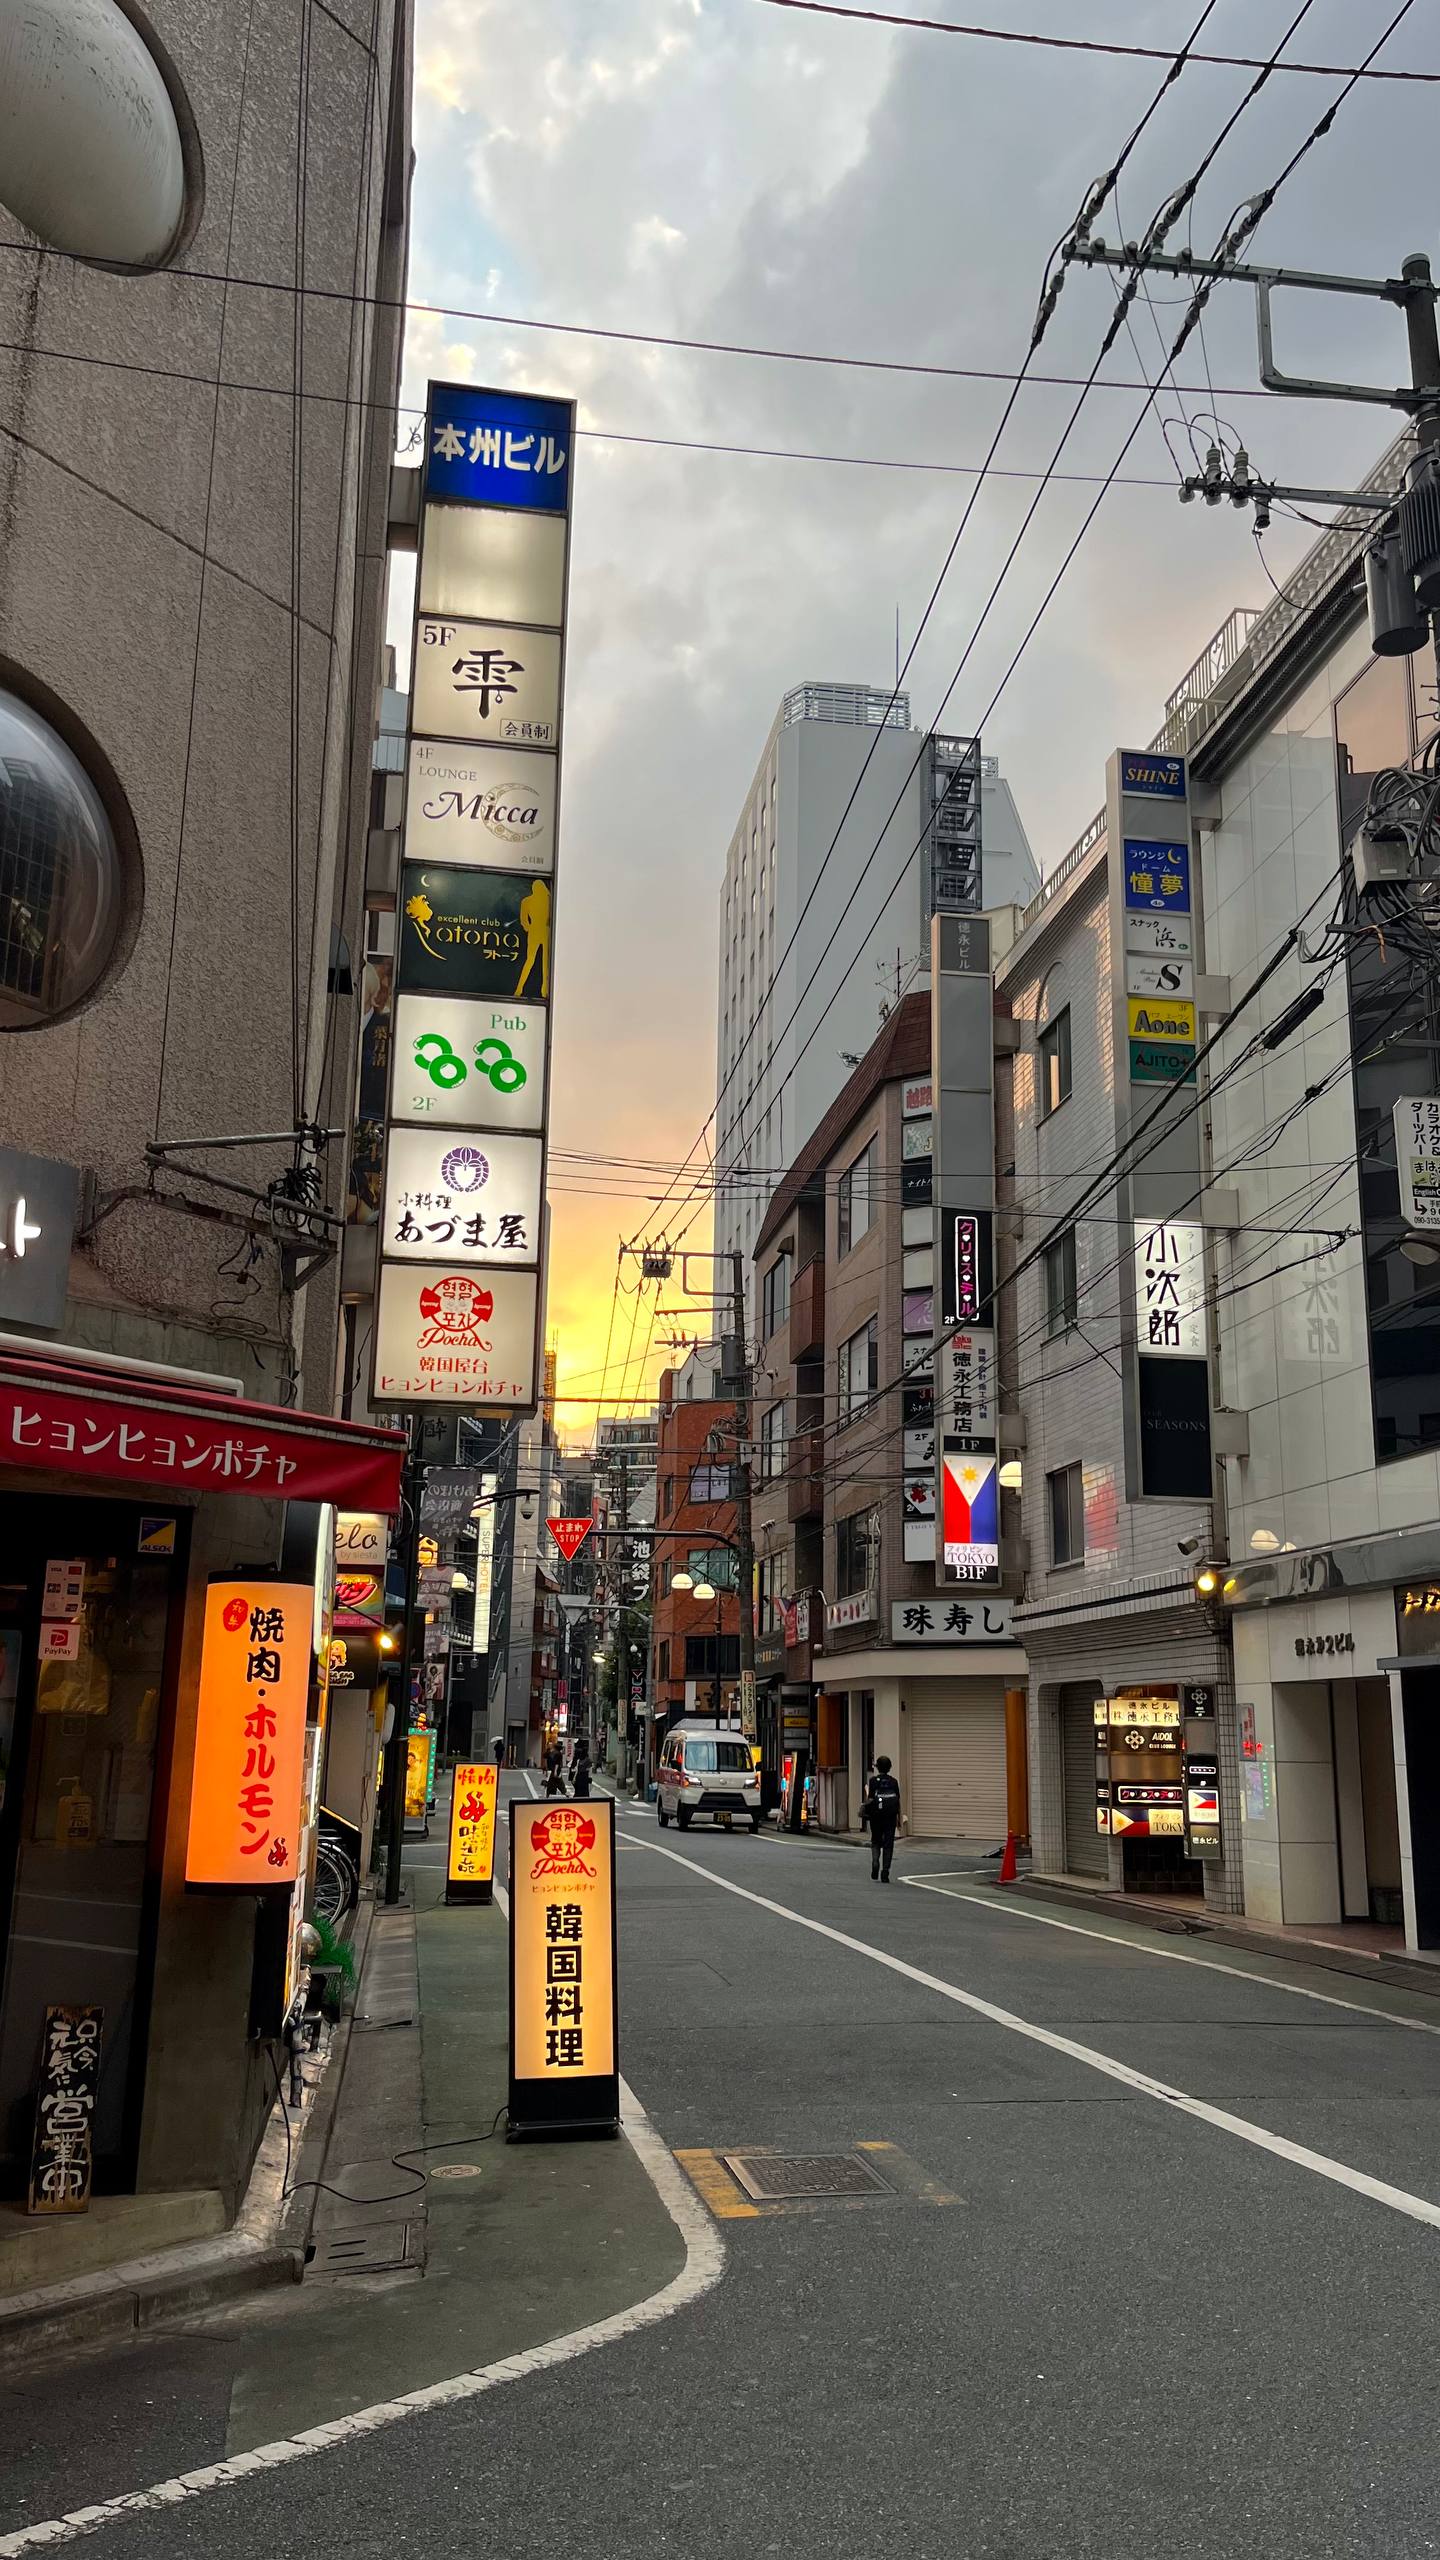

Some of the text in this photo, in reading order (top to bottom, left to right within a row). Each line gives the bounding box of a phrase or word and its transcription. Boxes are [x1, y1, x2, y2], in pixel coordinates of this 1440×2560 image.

[433, 423, 566, 474] 本州ビル
[423, 625, 456, 646] 5F
[505, 722, 549, 740] 会員制
[416, 747, 434, 759] 4F
[420, 766, 477, 781] LOUNGE
[1126, 767, 1180, 785] SHINE
[423, 792, 539, 825] Micca
[1130, 850, 1166, 860] ラウンジ
[1141, 863, 1171, 872] ドーム
[437, 915, 500, 926] excellent club
[1130, 919, 1159, 928] スナック
[958, 921, 971, 969] 徳永ビル
[1155, 927, 1177, 949] 浜
[1155, 963, 1184, 991] S
[491, 1014, 527, 1031] Pub
[1133, 1010, 1190, 1036] Aone
[412, 1096, 437, 1111] 2F
[1411, 1102, 1426, 1155] ダーツバー
[398, 1192, 452, 1210] 小料理
[1414, 1188, 1436, 1197] English
[394, 1210, 528, 1250] あづま屋
[1145, 1228, 1180, 1346] 小次郎
[945, 1315, 955, 1325] 2F
[417, 1326, 492, 1352] Pocha
[419, 1356, 488, 1374] 韓国屋台
[381, 1375, 523, 1397] ヒョンヒョンポチャ
[953, 1352, 972, 1433] 徳永工務店
[1146, 1419, 1206, 1432] SEASONS
[11, 1405, 298, 1484] ヒョンヒョンポチャ
[915, 1433, 929, 1441] 2F
[960, 1438, 980, 1451] 1F
[555, 1523, 584, 1532] 止まれ
[559, 1535, 580, 1543] STOP
[141, 1545, 171, 1553] ALSOK
[340, 1550, 378, 1560] by siesta
[948, 1552, 995, 1564] TOKYO
[480, 1530, 491, 1593] SUPER HOTEL
[956, 1565, 987, 1579] B1F
[903, 1603, 1004, 1636] 珠寿し
[44, 1648, 72, 1656] PayPay
[1128, 1702, 1170, 1710] 徳永ビル
[238, 1606, 284, 1855] 焼肉・ホルモン
[530, 1857, 597, 1879] Pocha
[532, 1883, 595, 1894] ヒョンヒョンポチャ
[545, 1903, 584, 2067] 韓国料理
[39, 2083, 95, 2198] 営業中
